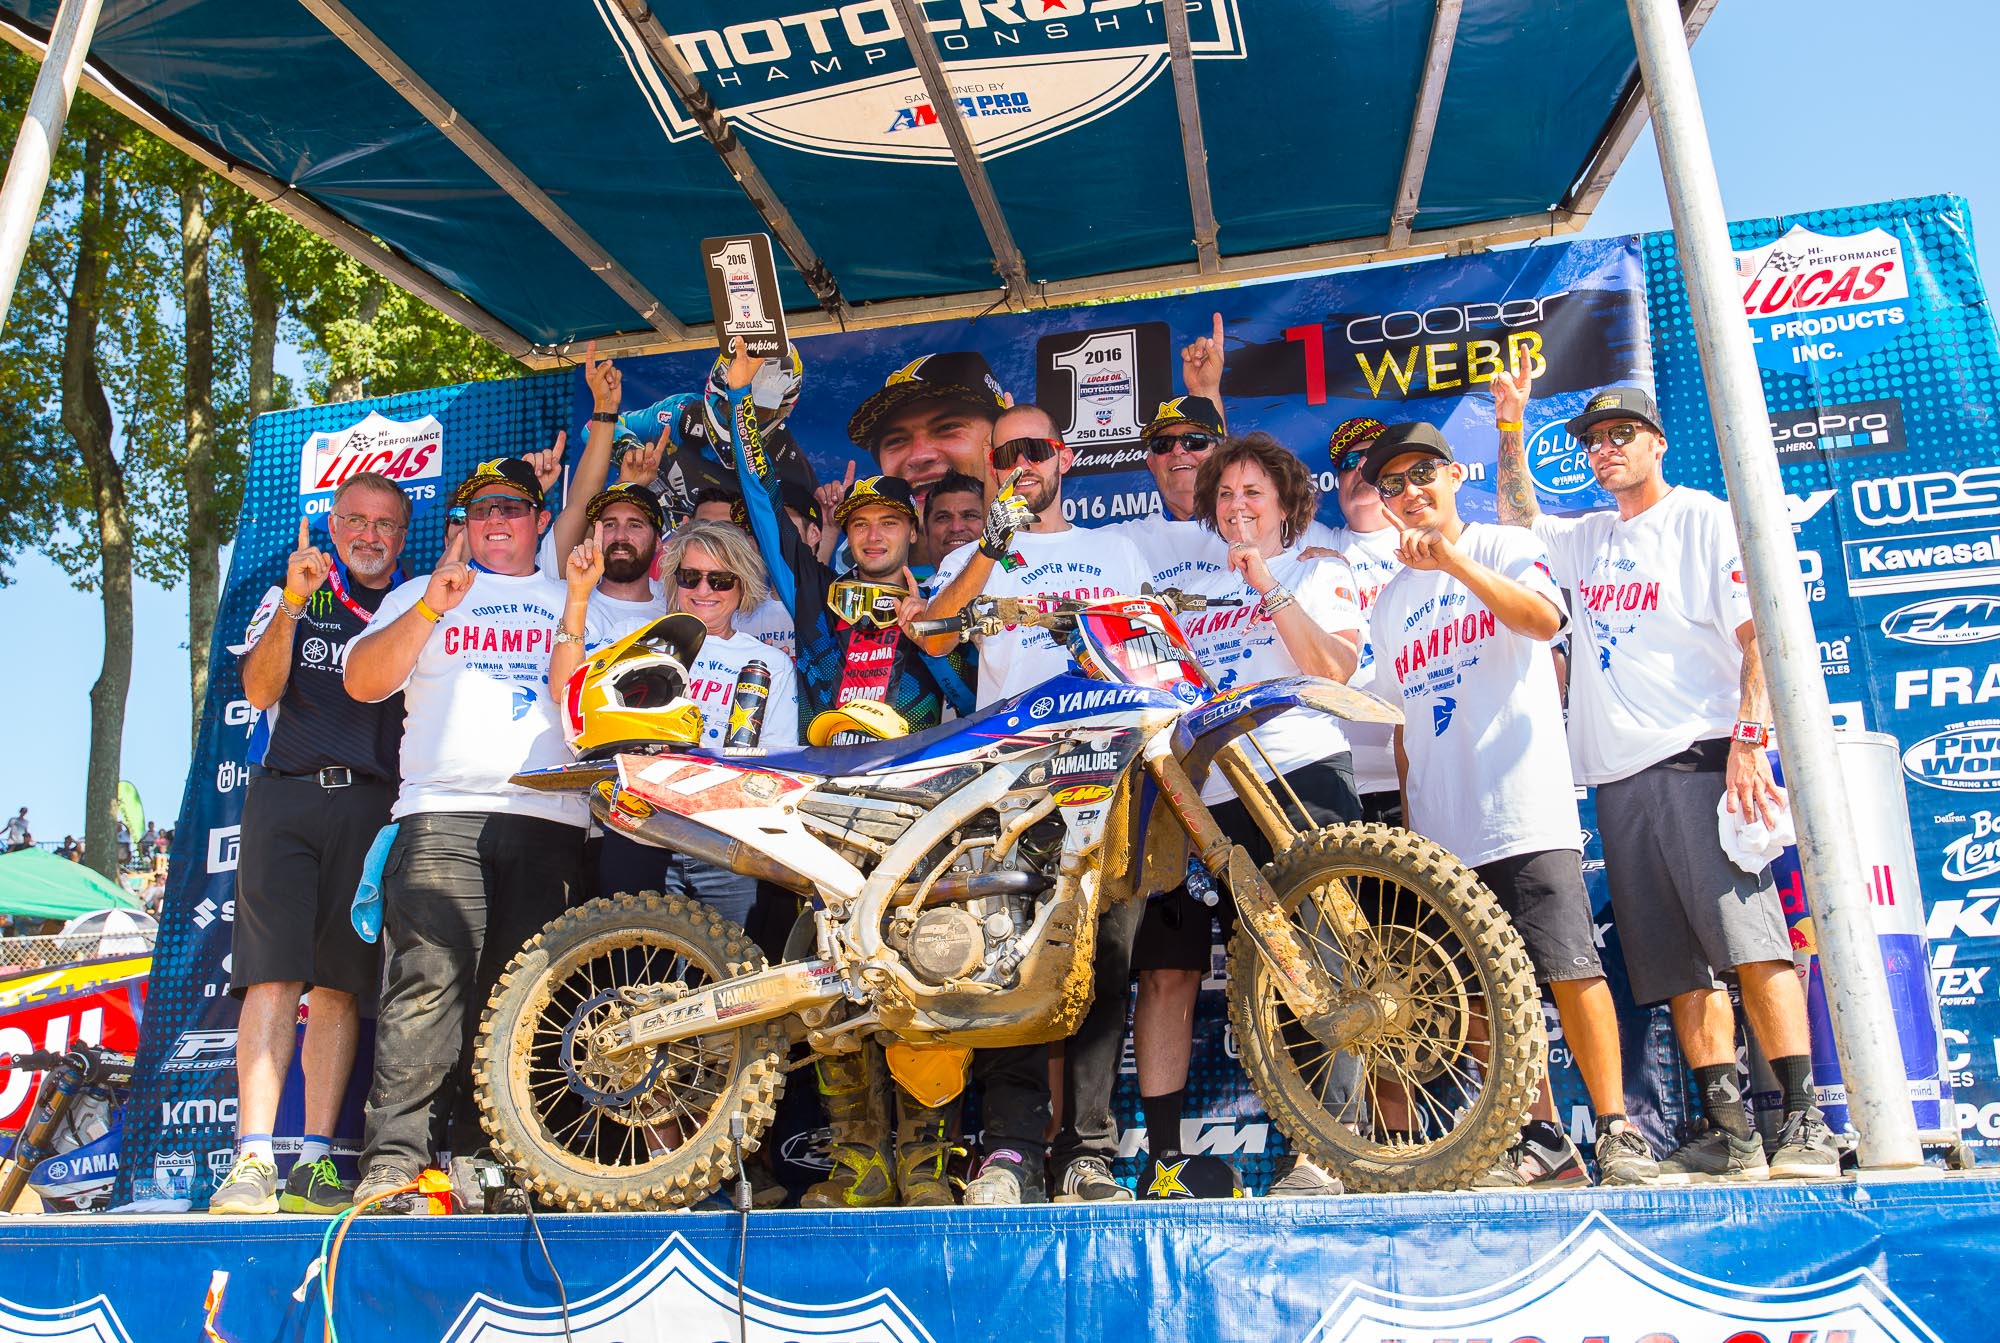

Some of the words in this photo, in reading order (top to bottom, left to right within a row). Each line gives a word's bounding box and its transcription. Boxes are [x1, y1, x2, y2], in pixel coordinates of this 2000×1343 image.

[988, 82, 1005, 92] BY
[976, 91, 1029, 109] PRO
[981, 106, 1032, 116] RACING
[727, 254, 747, 265] 2016
[1809, 247, 1897, 266] PERFORMANCE
[1743, 261, 1895, 315] LUCAS
[735, 321, 745, 329] 250
[746, 320, 763, 329] CLASS
[1771, 307, 1905, 339] PRODUCTS
[1085, 348, 1122, 364] 2016
[1792, 343, 1843, 364] INC.
[1285, 323, 1327, 406] 1
[1354, 330, 1547, 399] WEBB
[1087, 374, 1110, 383] LUCAS
[1110, 373, 1122, 381] OIL
[1080, 384, 1130, 394] MOTOCROSS
[378, 430, 390, 438] HI-
[1077, 429, 1096, 439] 250
[1099, 426, 1132, 438] CLASS
[1770, 413, 1888, 441] GoPro
[378, 431, 440, 447] PERFORMANCE
[736, 404, 750, 441] ENERGY
[743, 444, 757, 475] DRINK
[1786, 442, 1816, 452] HERO.
[314, 444, 437, 489] LUCAS
[1559, 472, 1586, 484] YAMAHA
[305, 497, 333, 515] OIL
[1062, 497, 1106, 521] 016
[1111, 490, 1162, 517] AMA
[1021, 562, 1063, 585] COOPER
[1067, 562, 1102, 577] WEBB
[1153, 561, 1192, 583] COOPER
[472, 603, 518, 617] COOPER
[522, 603, 555, 620] WEBB
[875, 599, 894, 608] 100%
[444, 625, 552, 655] CHAMPI
[1110, 642, 1124, 654] 250
[1214, 639, 1241, 652] YAMALUBE
[848, 651, 869, 663] 250
[869, 646, 893, 662] AMA
[300, 661, 344, 673] FACTO
[474, 662, 503, 670] YAMAHA
[508, 662, 539, 671] YAMALUBE
[1427, 665, 1454, 681] YAMALUBE
[840, 685, 885, 703] CHAMP
[1059, 689, 1151, 714] YAMAHA
[1944, 721, 1965, 731] THE
[724, 746, 769, 758] YAMAHA
[1051, 752, 1118, 776] YAMALUBE
[1942, 779, 1981, 788] BEARING
[1054, 786, 1113, 804] FMF
[162, 1057, 238, 1072] PROGRI
[162, 1125, 236, 1135] WHEELS
[70, 1151, 120, 1176] YAMA
